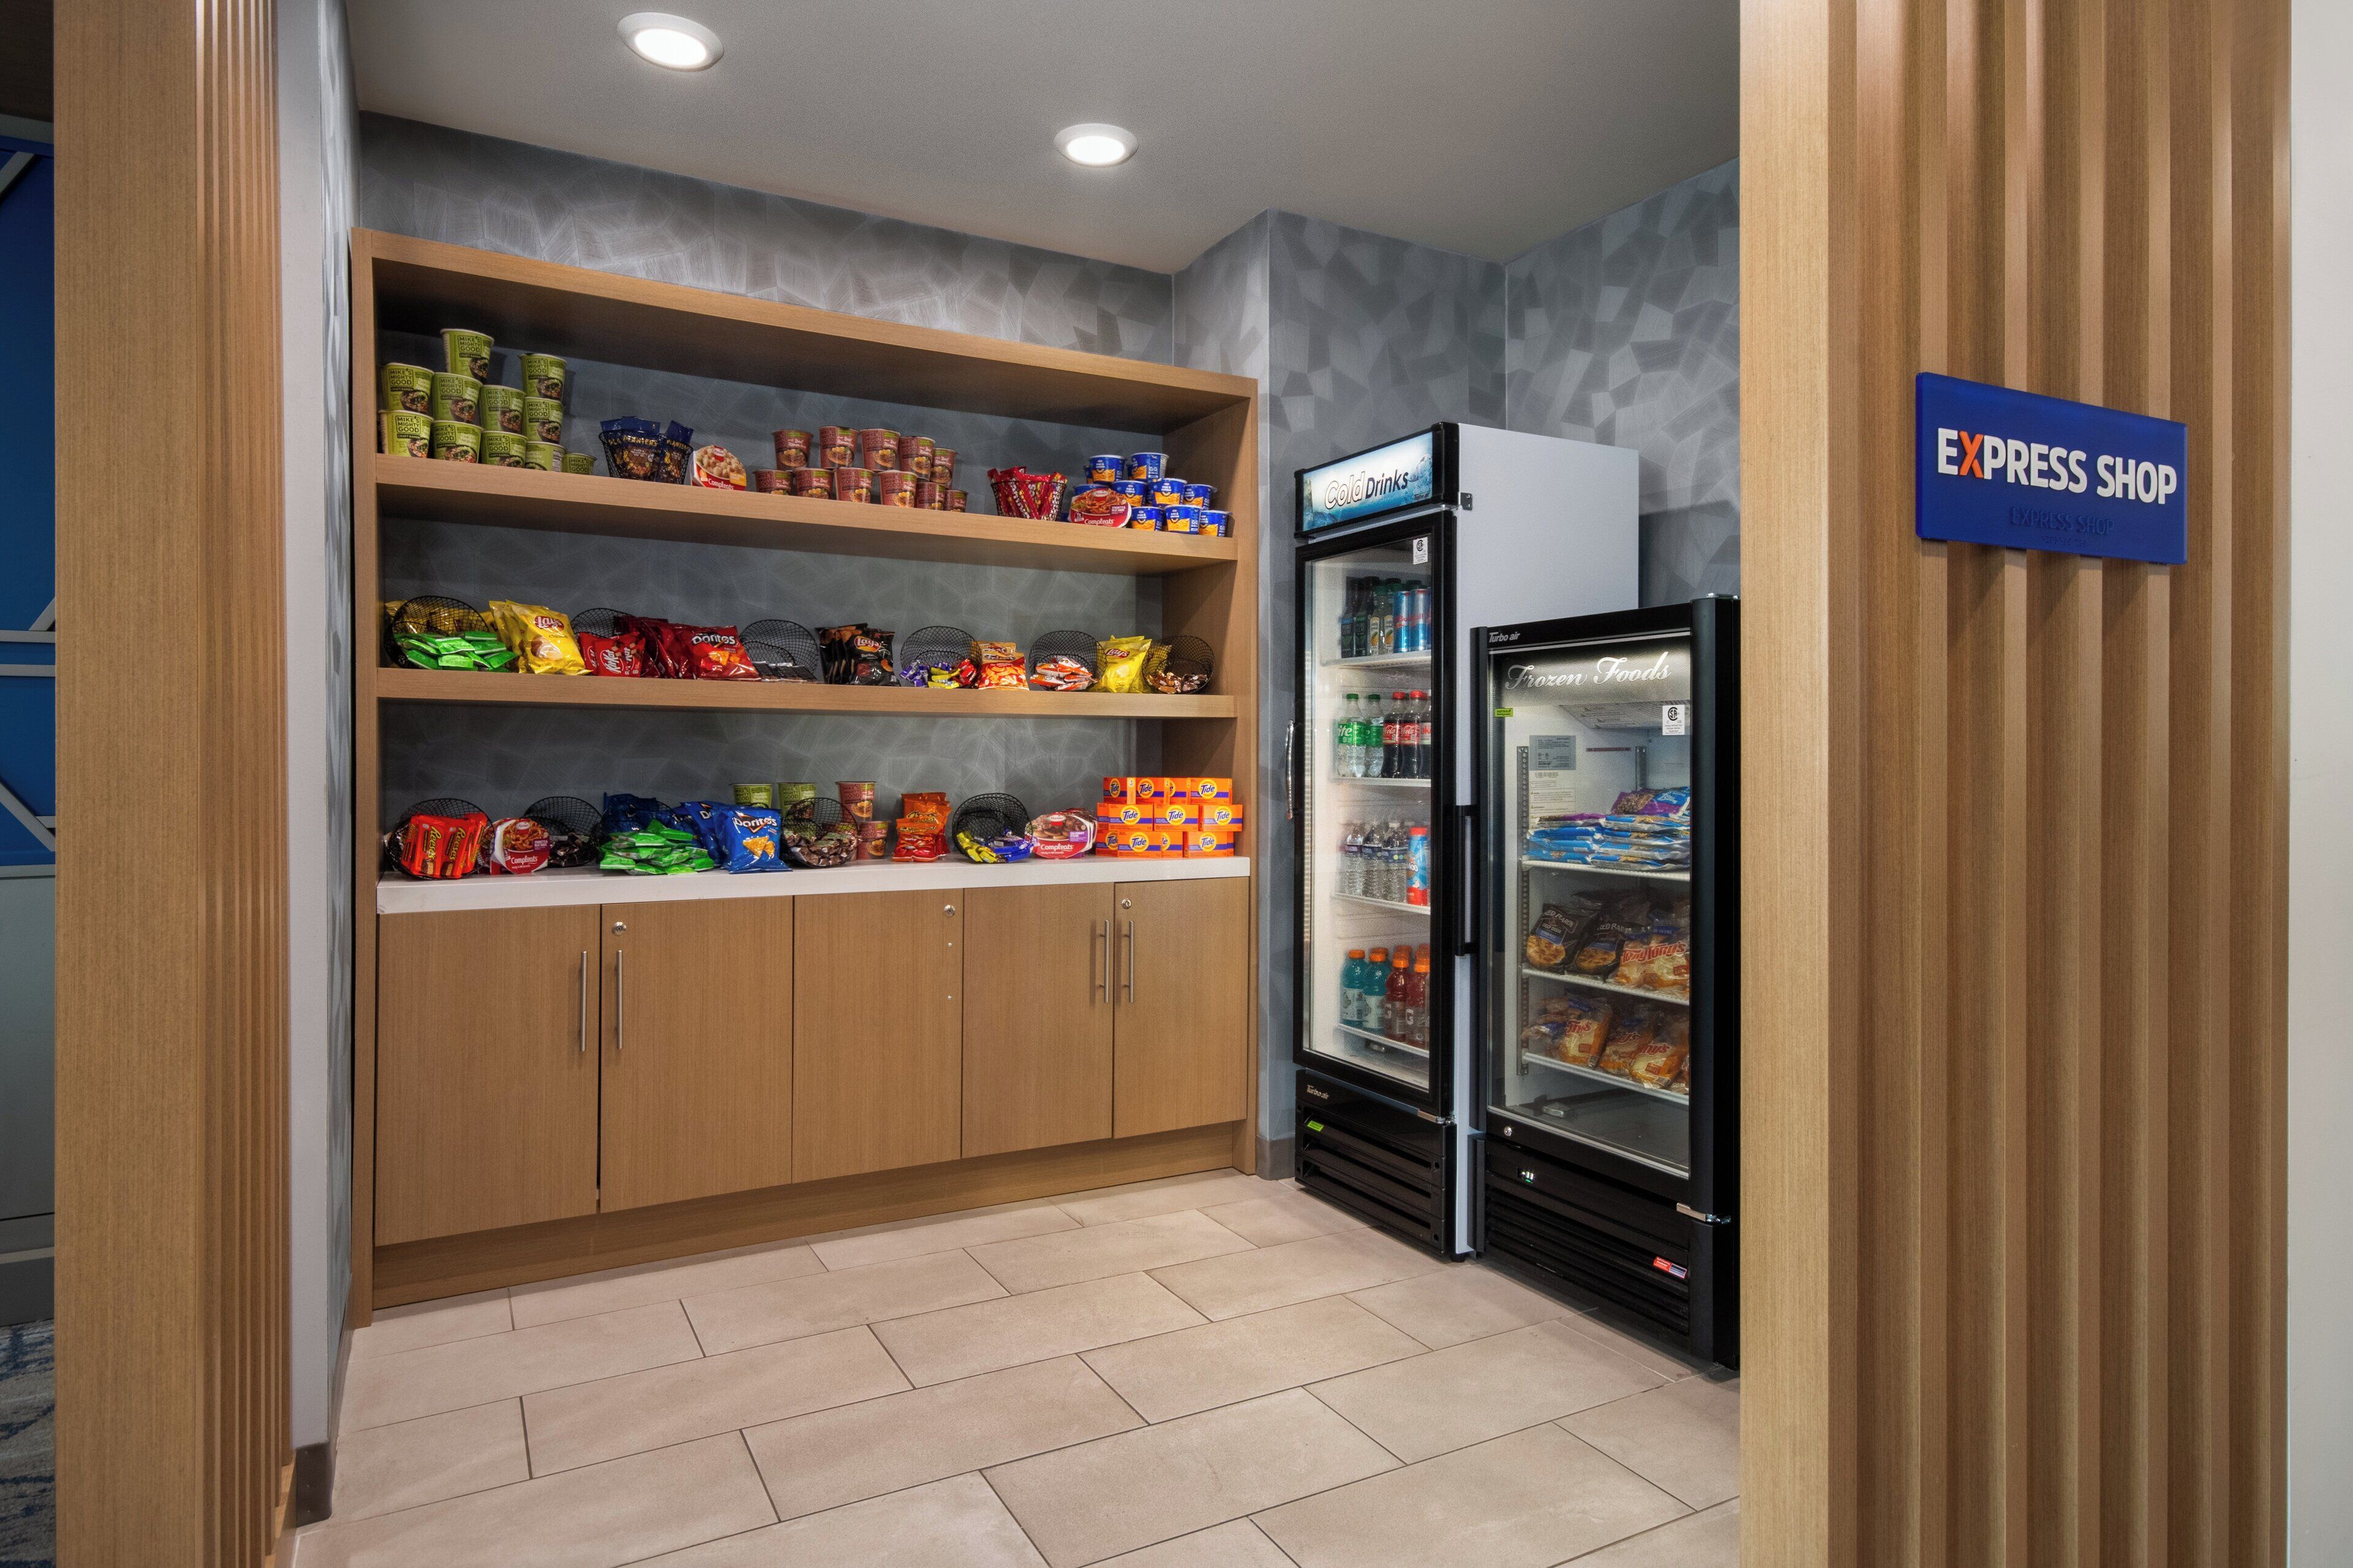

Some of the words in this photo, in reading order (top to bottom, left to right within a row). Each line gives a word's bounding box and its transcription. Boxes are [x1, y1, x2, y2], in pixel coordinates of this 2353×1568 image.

[397, 415, 420, 423] MIKE'S
[1938, 427, 2087, 493] EXPRESS
[2096, 455, 2177, 505] SHOP
[1325, 471, 1365, 509] Cold
[1365, 469, 1409, 499] Drinks
[2011, 507, 2074, 531] EXPRESS
[2077, 515, 2114, 535] SHOP
[691, 633, 736, 645] Doritos
[1489, 632, 1509, 643] Turbo
[1509, 631, 1520, 641] air
[1106, 648, 1129, 657] Lay's
[1505, 664, 1588, 690] Frozen
[1593, 651, 1672, 685] Foods
[1110, 783, 1120, 793] Tide
[1140, 784, 1153, 794] Tide
[1201, 784, 1215, 795] Tide
[1123, 810, 1139, 821] Tide
[1169, 811, 1184, 821] Tide
[1216, 811, 1230, 821] Tide
[733, 817, 778, 828] Doritos
[429, 825, 442, 860] Reese's
[449, 827, 466, 862] Reese's
[1107, 836, 1118, 846] Tid
[1132, 837, 1147, 848] Tide
[1201, 837, 1214, 848] Tide
[1040, 843, 1074, 852] Compleats
[510, 855, 538, 865] Compleats
[1647, 941, 1688, 960] Tony's
